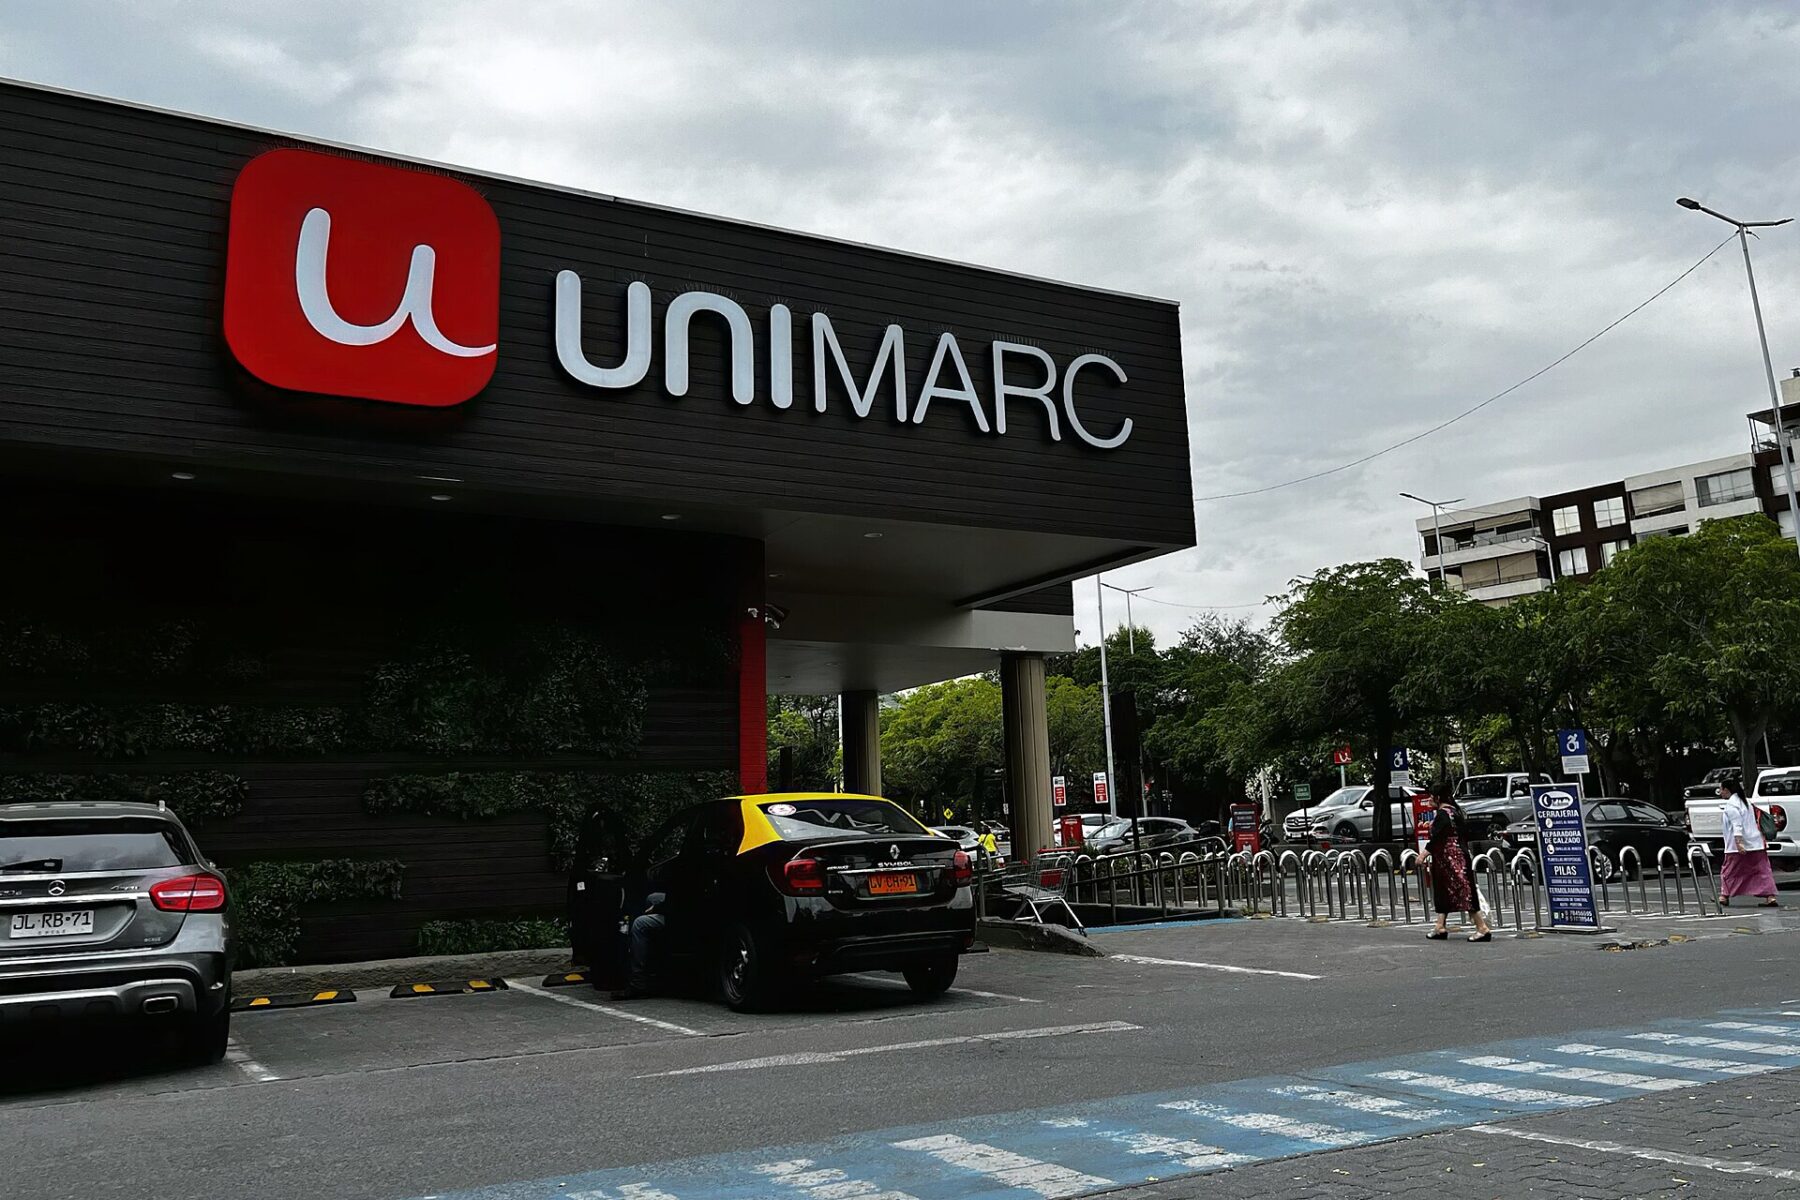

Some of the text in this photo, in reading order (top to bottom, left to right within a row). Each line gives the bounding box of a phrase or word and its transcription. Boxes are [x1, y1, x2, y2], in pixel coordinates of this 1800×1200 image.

[555, 269, 1134, 449] UNIMARC
[1537, 810, 1579, 818] CERRAJERIA
[1542, 830, 1582, 838] REPARADORA
[1553, 865, 1577, 876] PILAS
